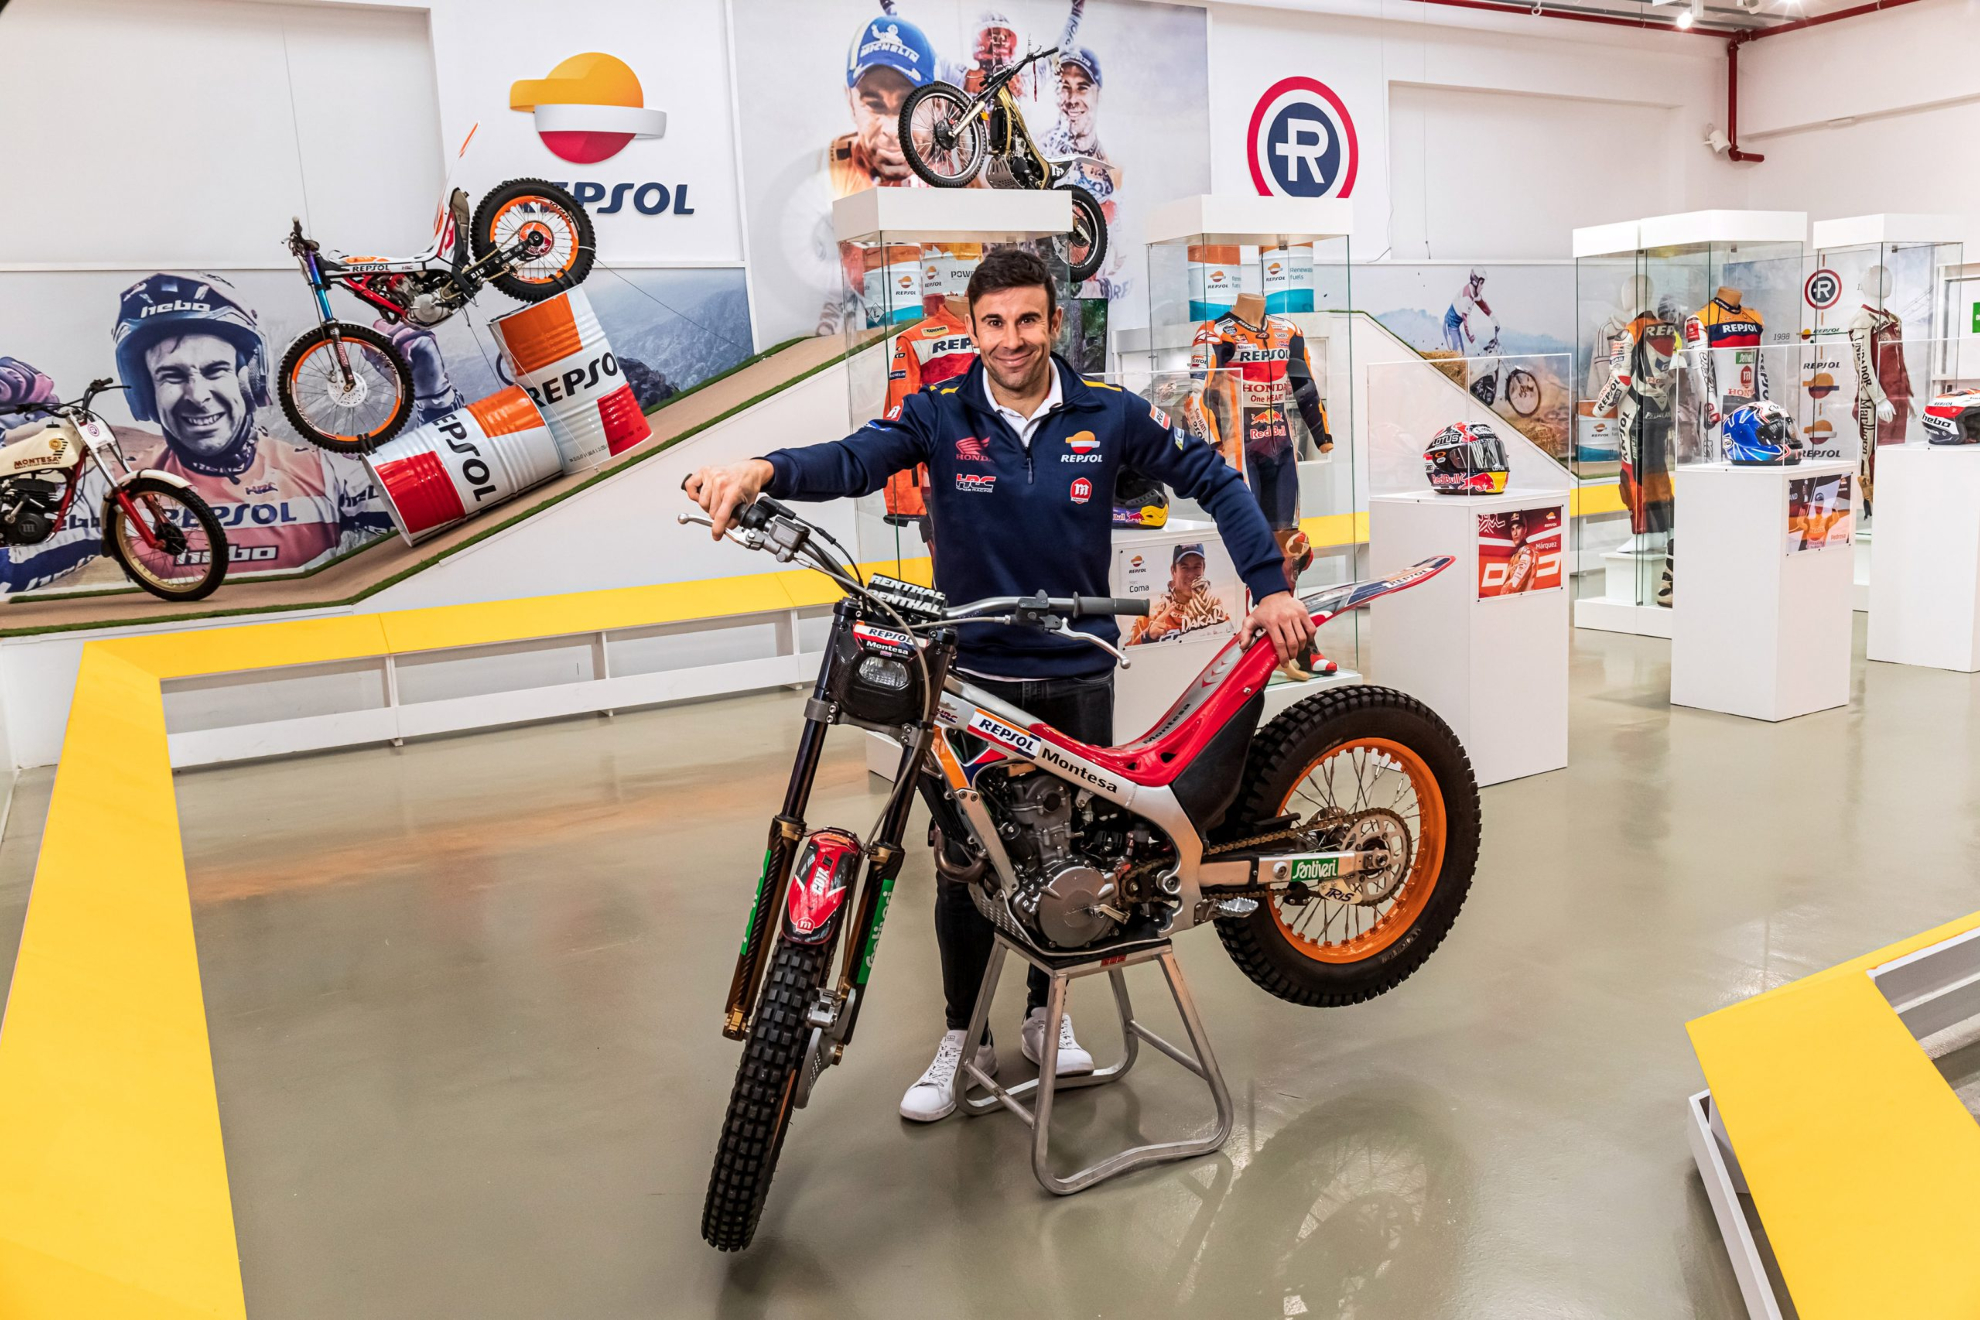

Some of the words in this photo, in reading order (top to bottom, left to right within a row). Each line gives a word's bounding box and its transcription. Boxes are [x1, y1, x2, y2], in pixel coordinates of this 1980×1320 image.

[860, 40, 920, 64] MICHELIN
[521, 181, 695, 216] PSOL
[352, 264, 390, 273] REPSOL
[140, 299, 211, 318] hebo
[1722, 323, 1758, 334] REPSOL
[1802, 361, 1841, 370] REPSOL
[1250, 395, 1265, 403] One
[1922, 413, 1952, 428] hebo
[1250, 427, 1272, 440] Red
[1432, 433, 1461, 447] LOTUS
[14, 456, 58, 468] MONTESA
[1060, 454, 1103, 463] REPSOL
[1535, 541, 1558, 550] Márquez
[870, 575, 946, 600] RENTHAL
[1129, 584, 1150, 593] Coma
[1181, 604, 1225, 633] DAKAR
[866, 640, 909, 655] Montesa
[1142, 703, 1191, 745] Montesa
[978, 718, 1035, 752] REPSOL
[1041, 746, 1118, 794] Montesa
[1292, 857, 1338, 879] Santiveri
[1325, 888, 1355, 902] IRIS
